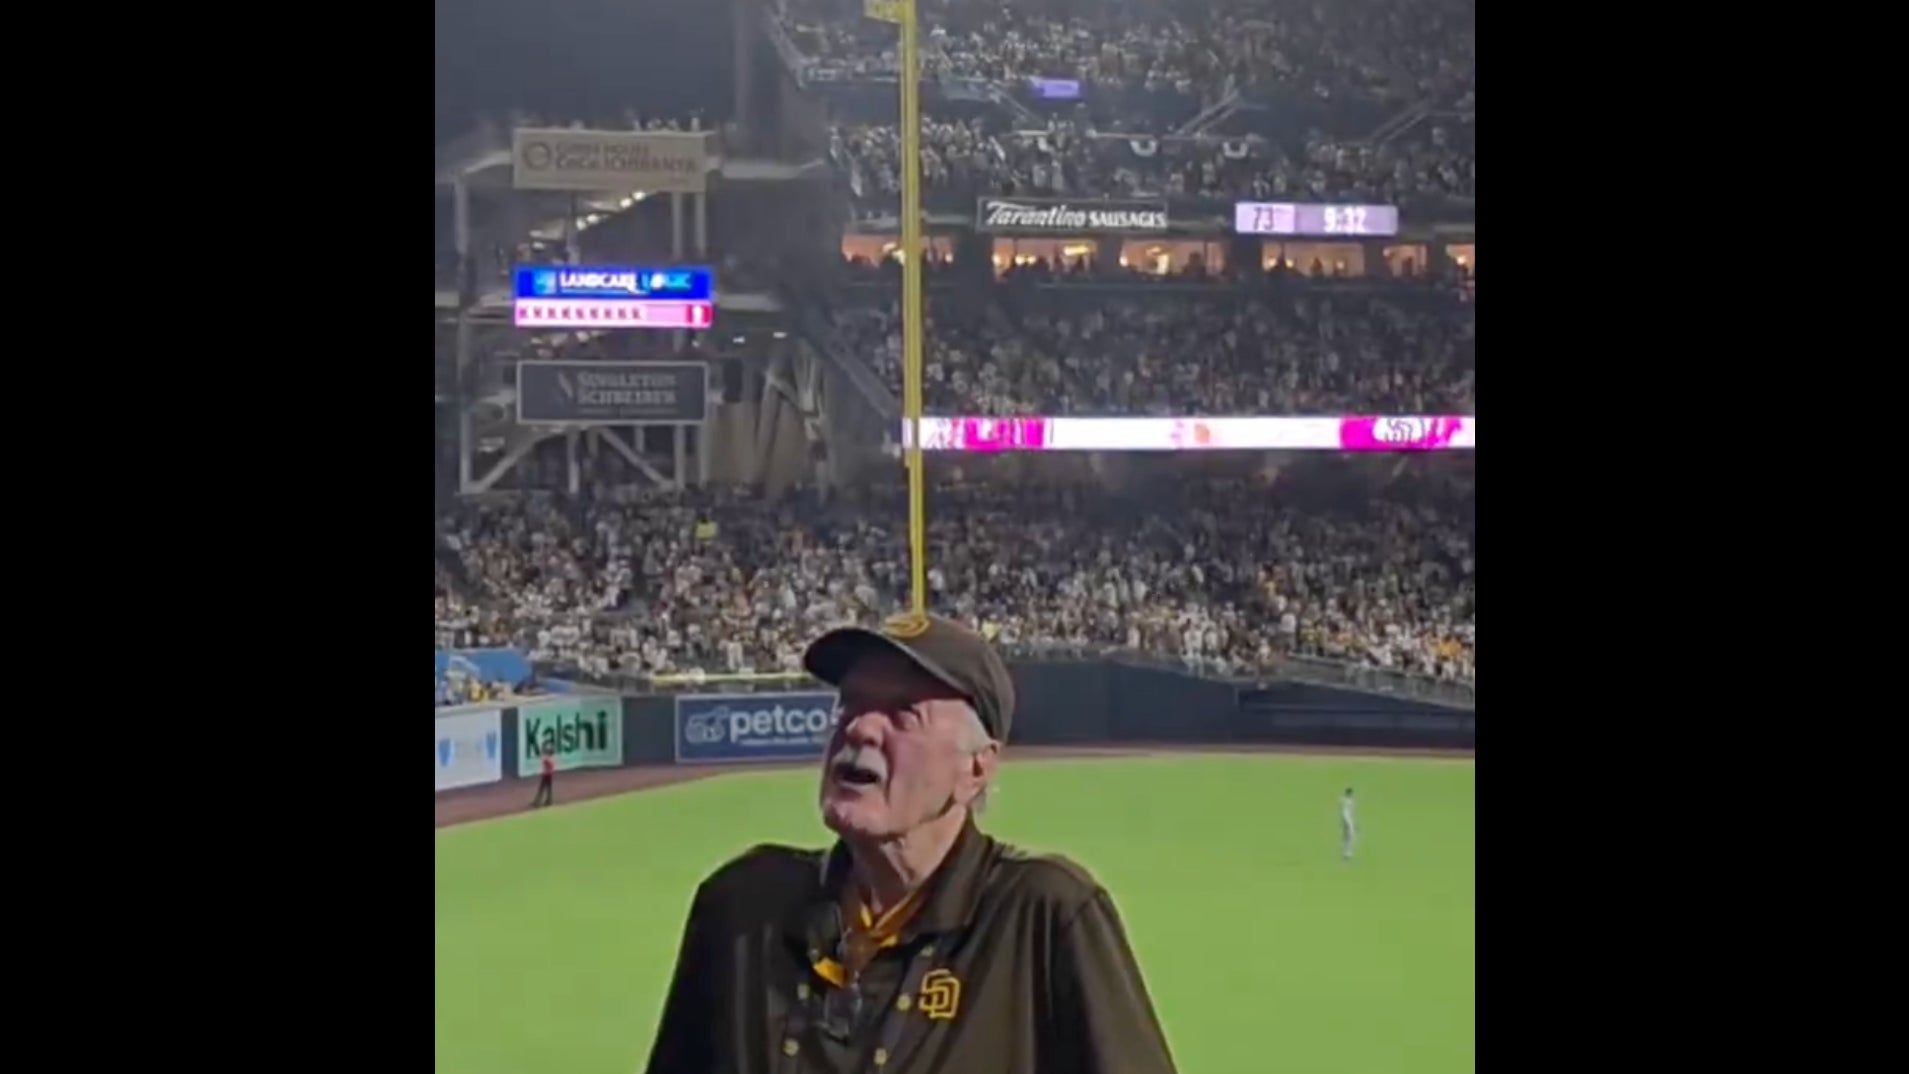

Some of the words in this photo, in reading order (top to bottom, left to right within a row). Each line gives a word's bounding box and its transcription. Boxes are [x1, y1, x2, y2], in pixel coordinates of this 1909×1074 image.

[986, 201, 1085, 226] Tarantino
[525, 711, 608, 759] Kalshi
[730, 704, 828, 744] petco
